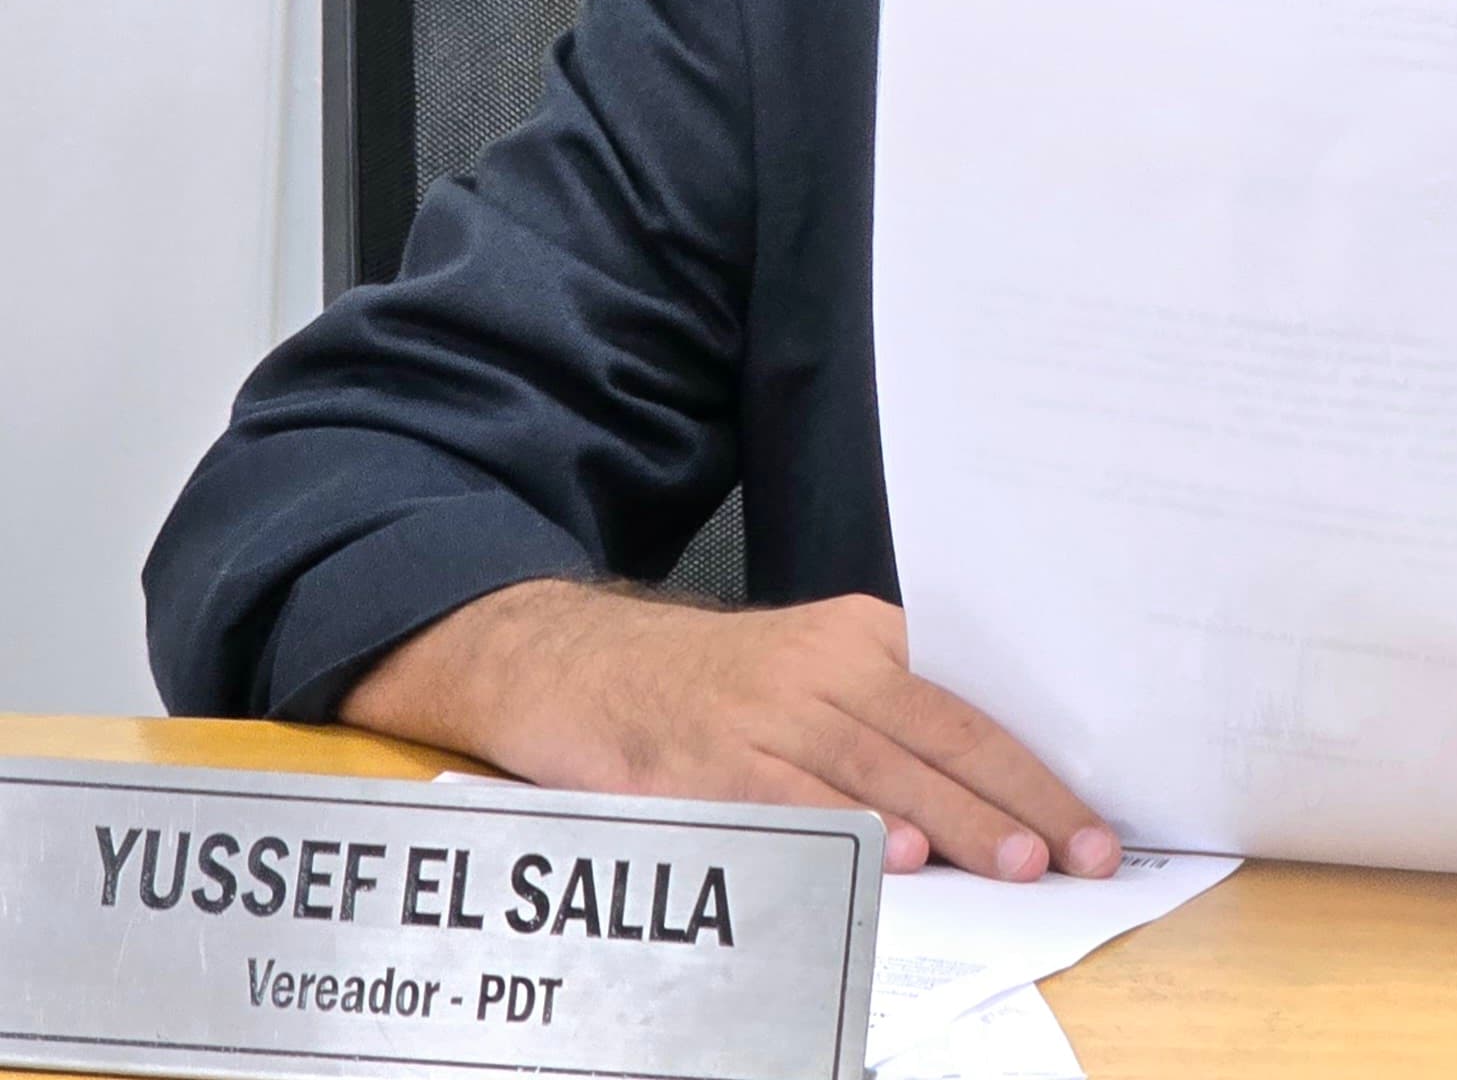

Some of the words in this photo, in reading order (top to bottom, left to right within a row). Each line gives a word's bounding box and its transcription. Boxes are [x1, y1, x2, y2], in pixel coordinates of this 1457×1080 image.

[95, 825, 387, 922] YUSSEF
[401, 846, 484, 930] EL
[505, 853, 734, 947] SALLA
[248, 957, 440, 1017] Vereador
[477, 973, 563, 1026] PDT
